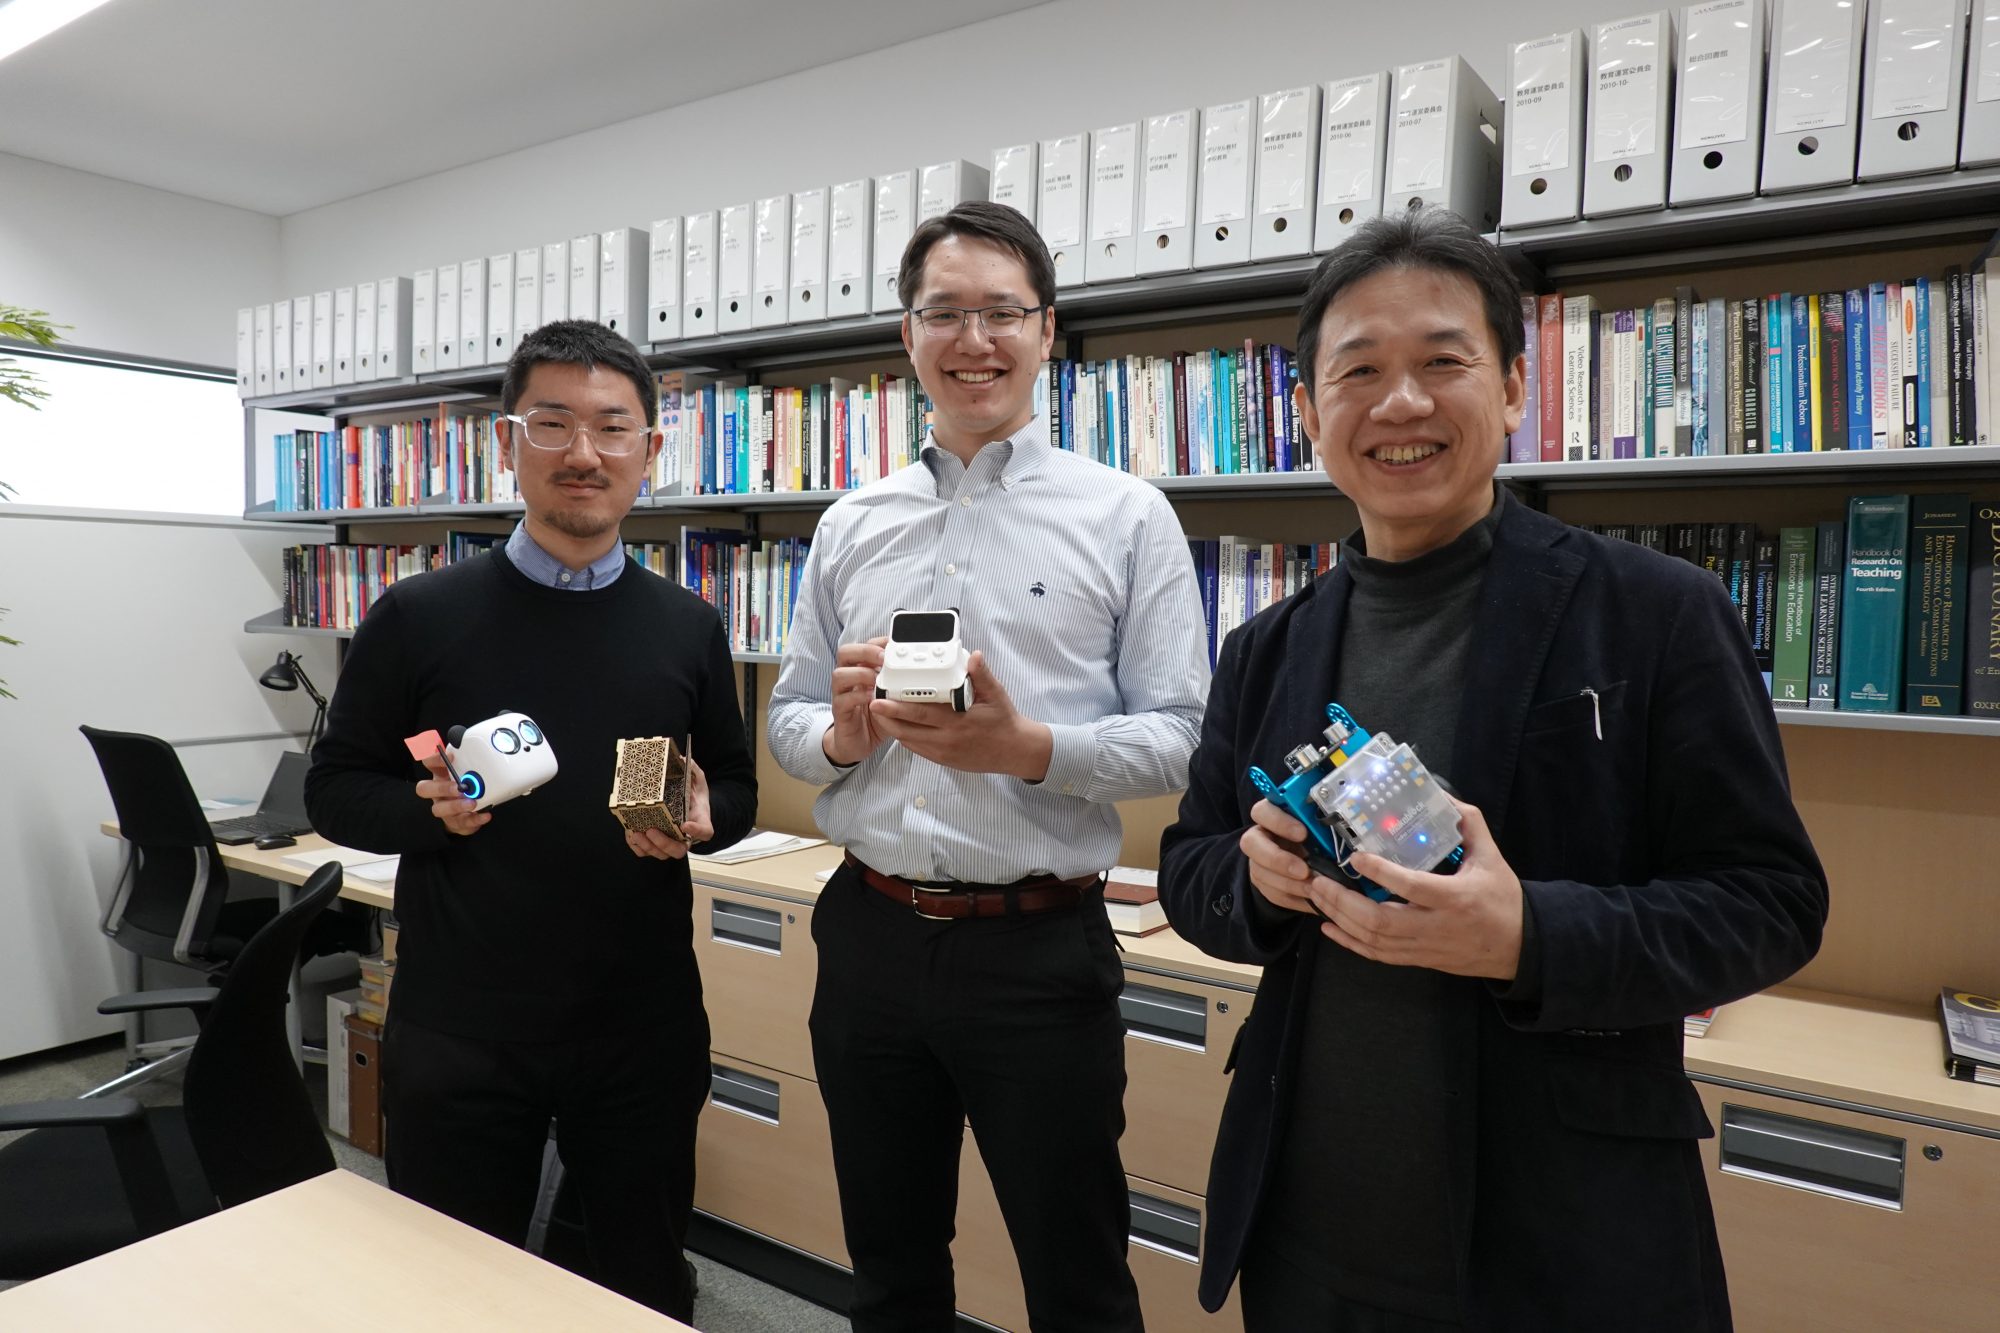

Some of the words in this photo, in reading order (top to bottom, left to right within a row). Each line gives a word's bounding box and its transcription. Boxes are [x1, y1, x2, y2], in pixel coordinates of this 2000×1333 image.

[1680, 299, 1688, 338] COGNITION
[1952, 300, 1960, 317] Styles
[1733, 311, 1742, 340] Practical
[1953, 328, 1961, 353] Learning
[1577, 346, 1585, 369] Video
[1680, 339, 1688, 348] IN
[1680, 349, 1688, 362] THE
[1853, 323, 1863, 362] Perspectives
[1567, 351, 1576, 385] Learning
[1656, 334, 1674, 384] UNSCHOOLED
[1680, 363, 1688, 382] WILD
[1732, 341, 1743, 381] Intelligence
[1796, 344, 1806, 398] Professionalism
[1830, 340, 1840, 381] COGNITION
[1890, 341, 1899, 383] SUCCESSFUL
[1953, 353, 1961, 380] Strategies
[1546, 373, 1555, 402] Students
[1577, 370, 1585, 406] Research
[1603, 371, 1612, 382] and
[1854, 371, 1864, 394] Activity
[1568, 387, 1577, 421] Sciences
[1602, 383, 1612, 413] Learning
[1655, 385, 1674, 408] MIND
[1733, 390, 1743, 419] Everyday
[1745, 387, 1757, 430] CHARACTER
[1855, 394, 1865, 416] Theory
[1874, 367, 1888, 419] SCHOOLS
[1891, 383, 1900, 411] FAILURE
[1734, 420, 1743, 433] Life
[1799, 399, 1808, 425] Reborn
[1832, 400, 1841, 432] CHANCE
[725, 416, 733, 454] WEB-BASED
[1238, 420, 1247, 442] THE
[1292, 417, 1301, 444] literacy
[725, 455, 733, 485] TRAINING
[1239, 443, 1248, 474] MEDIA
[1851, 558, 1888, 566] Research
[1889, 558, 1903, 566] On
[1852, 549, 1890, 557] Handbook
[1892, 549, 1904, 557] Of
[1933, 535, 1944, 596] EDUCATIONAL
[1944, 535, 1955, 585] HANDBOOK
[1262, 568, 1271, 599] InterViews
[1788, 553, 1797, 591] Emotions
[1796, 553, 1806, 593] International
[1820, 574, 1829, 592] THE
[1851, 567, 1902, 580] Teaching
[1921, 555, 1933, 614] TECHNOLOGY
[1742, 571, 1750, 606] CAMBRIDGE
[1755, 571, 1767, 617] Visuospatial
[1765, 581, 1773, 612] CAMBRIDGE
[1788, 592, 1796, 600] in
[1828, 574, 1837, 626] INTERNATIONAL
[1943, 587, 1951, 600] OF
[1785, 602, 1796, 642] Education
[1795, 594, 1804, 627] Handbook
[1818, 593, 1828, 635] LEARNING
[1941, 601, 1952, 646] RESEARCH
[1753, 617, 1765, 650] Thinking
[1826, 627, 1835, 665] HANDBOOK
[1929, 597, 1942, 677] COMMUNICATIONS
[1816, 636, 1827, 675] SCIENCES
[1941, 648, 1949, 661] ON
[1825, 666, 1832, 675] OF
